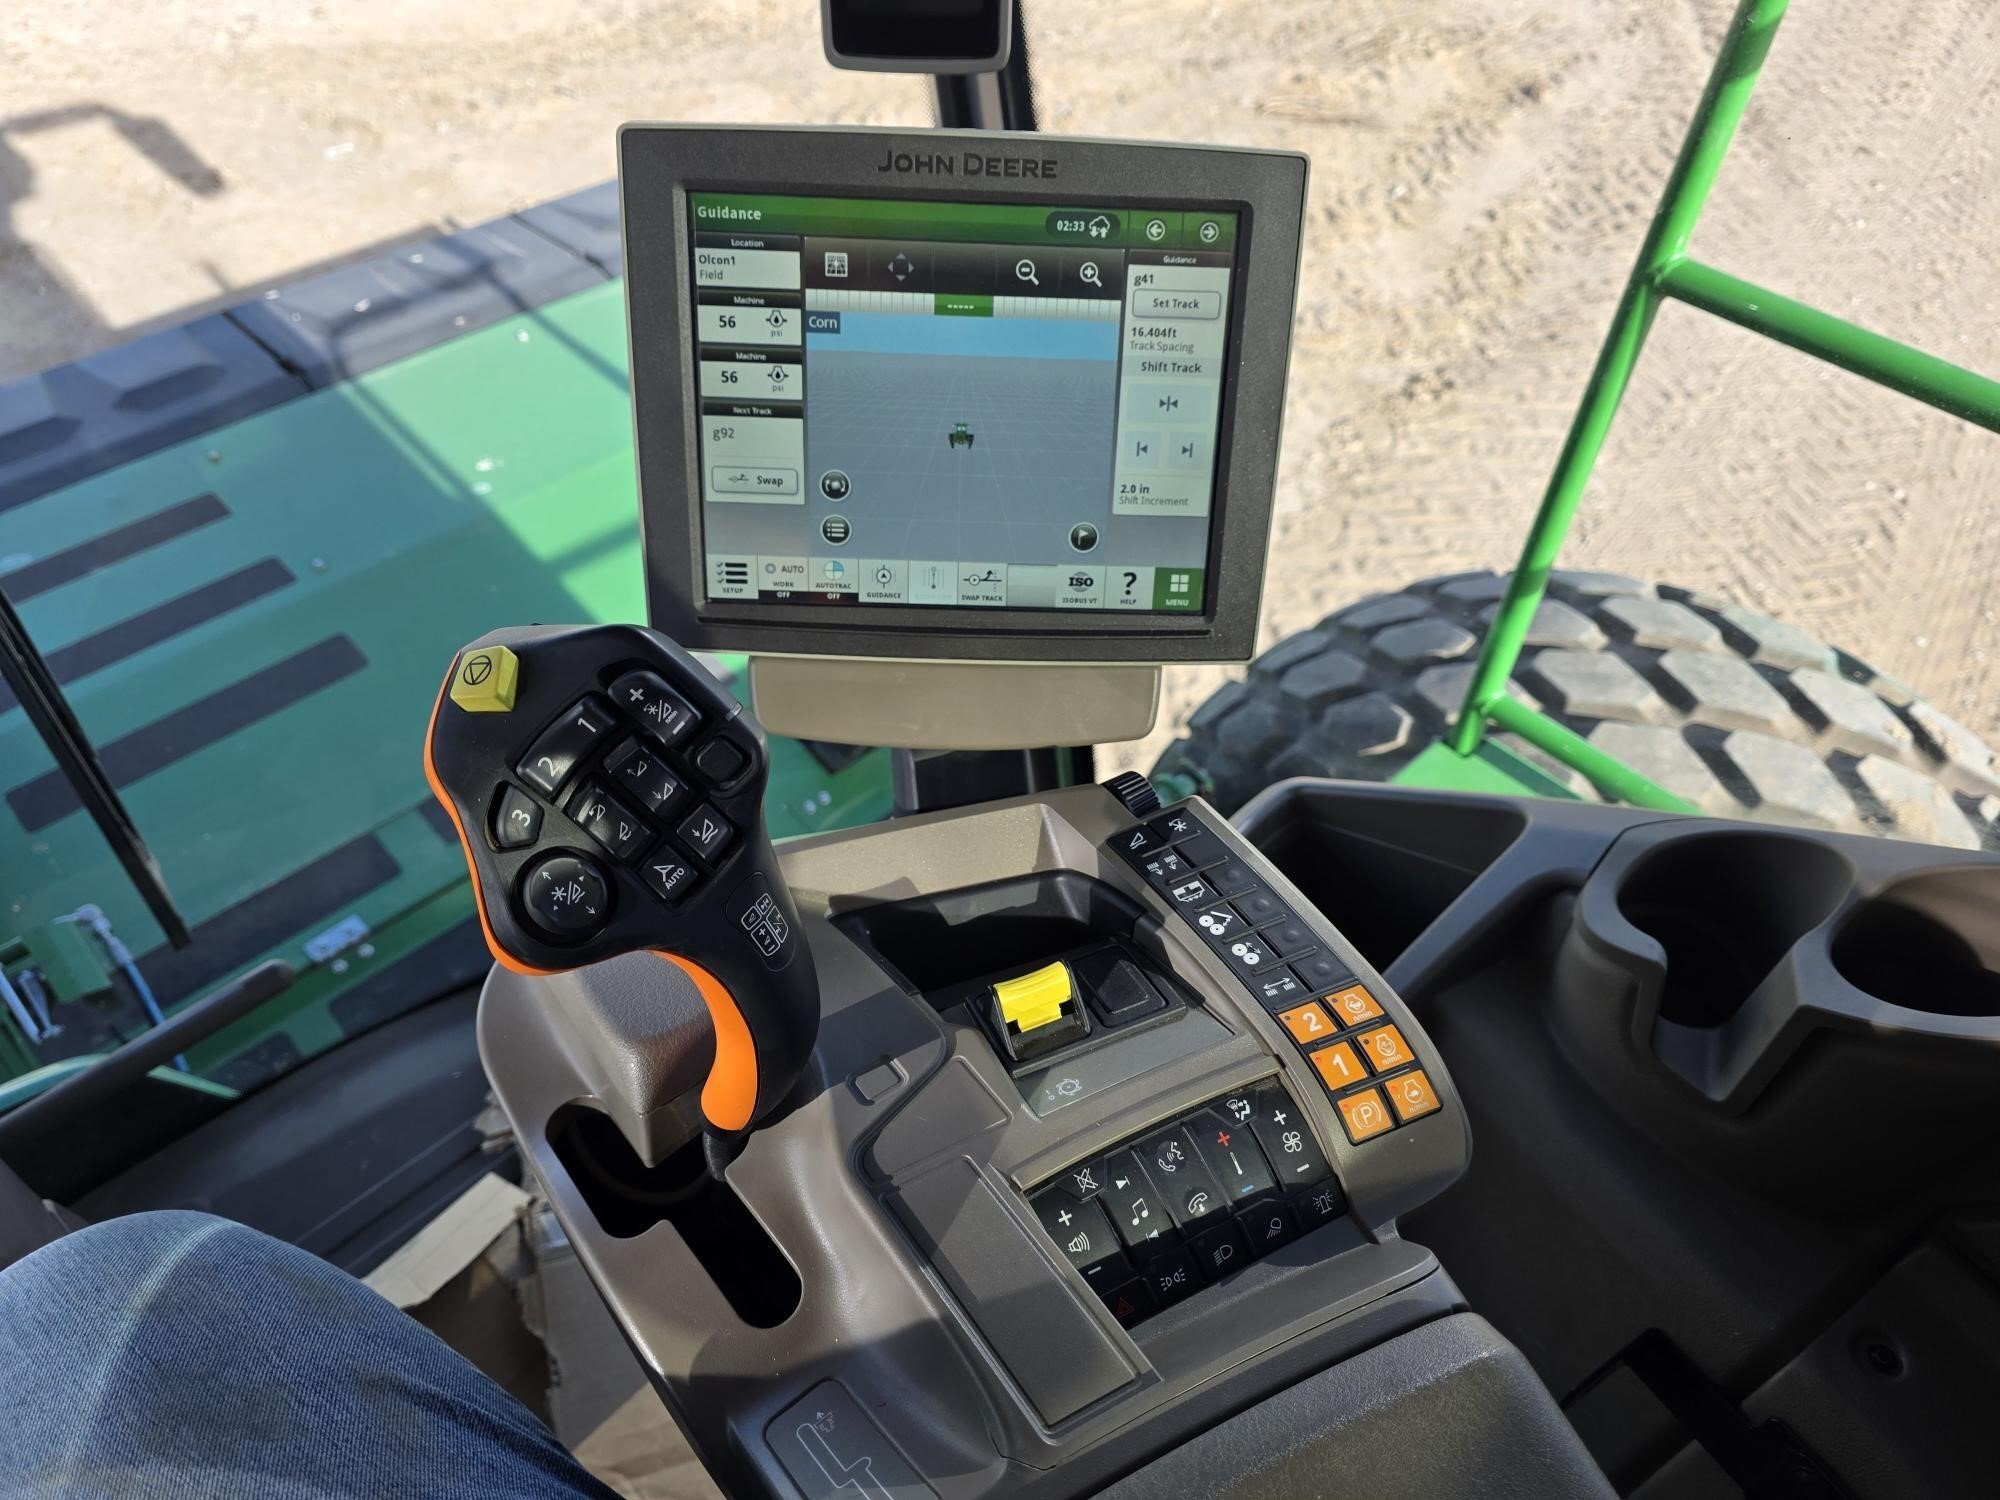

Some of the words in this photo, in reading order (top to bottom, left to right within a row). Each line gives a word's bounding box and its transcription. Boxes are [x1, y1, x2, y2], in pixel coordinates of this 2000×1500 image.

[878, 150, 953, 175] JOHN
[963, 153, 1058, 178] DEERE
[698, 206, 762, 220] Guidance
[1057, 220, 1085, 232] 02:33
[731, 239, 764, 248] Location
[698, 254, 736, 265] Olcon1
[1163, 255, 1197, 264] Guidance
[699, 269, 724, 280] Field
[1134, 274, 1154, 286] g41
[734, 296, 765, 305] Machine
[1152, 298, 1170, 308] Set
[1172, 299, 1200, 309] Track
[719, 315, 736, 328] 56
[808, 316, 838, 329] Corn
[770, 329, 783, 338] psi
[1131, 327, 1177, 338] 16.404ft
[1130, 340, 1156, 351] Track
[1156, 342, 1194, 353] Spacing
[736, 352, 767, 361] Machine
[1141, 361, 1168, 372] Shift
[1171, 362, 1202, 373] Track
[721, 371, 738, 384] 56
[772, 384, 785, 393] psi
[733, 406, 750, 414] Next
[752, 407, 772, 415] Track
[713, 428, 735, 441] g92
[757, 475, 784, 487] Swap
[1120, 484, 1136, 494] 2.0
[1139, 485, 1150, 494] in
[1118, 496, 1138, 505] Shift
[1141, 497, 1189, 506] Increment
[781, 565, 804, 574] AUTO
[1068, 576, 1094, 587] ISO
[577, 717, 597, 733] 1
[537, 756, 559, 776] 2
[511, 810, 531, 827] 3
[664, 867, 685, 890] AUTO
[1302, 1012, 1322, 1031] 2
[1332, 1053, 1349, 1076] 1
